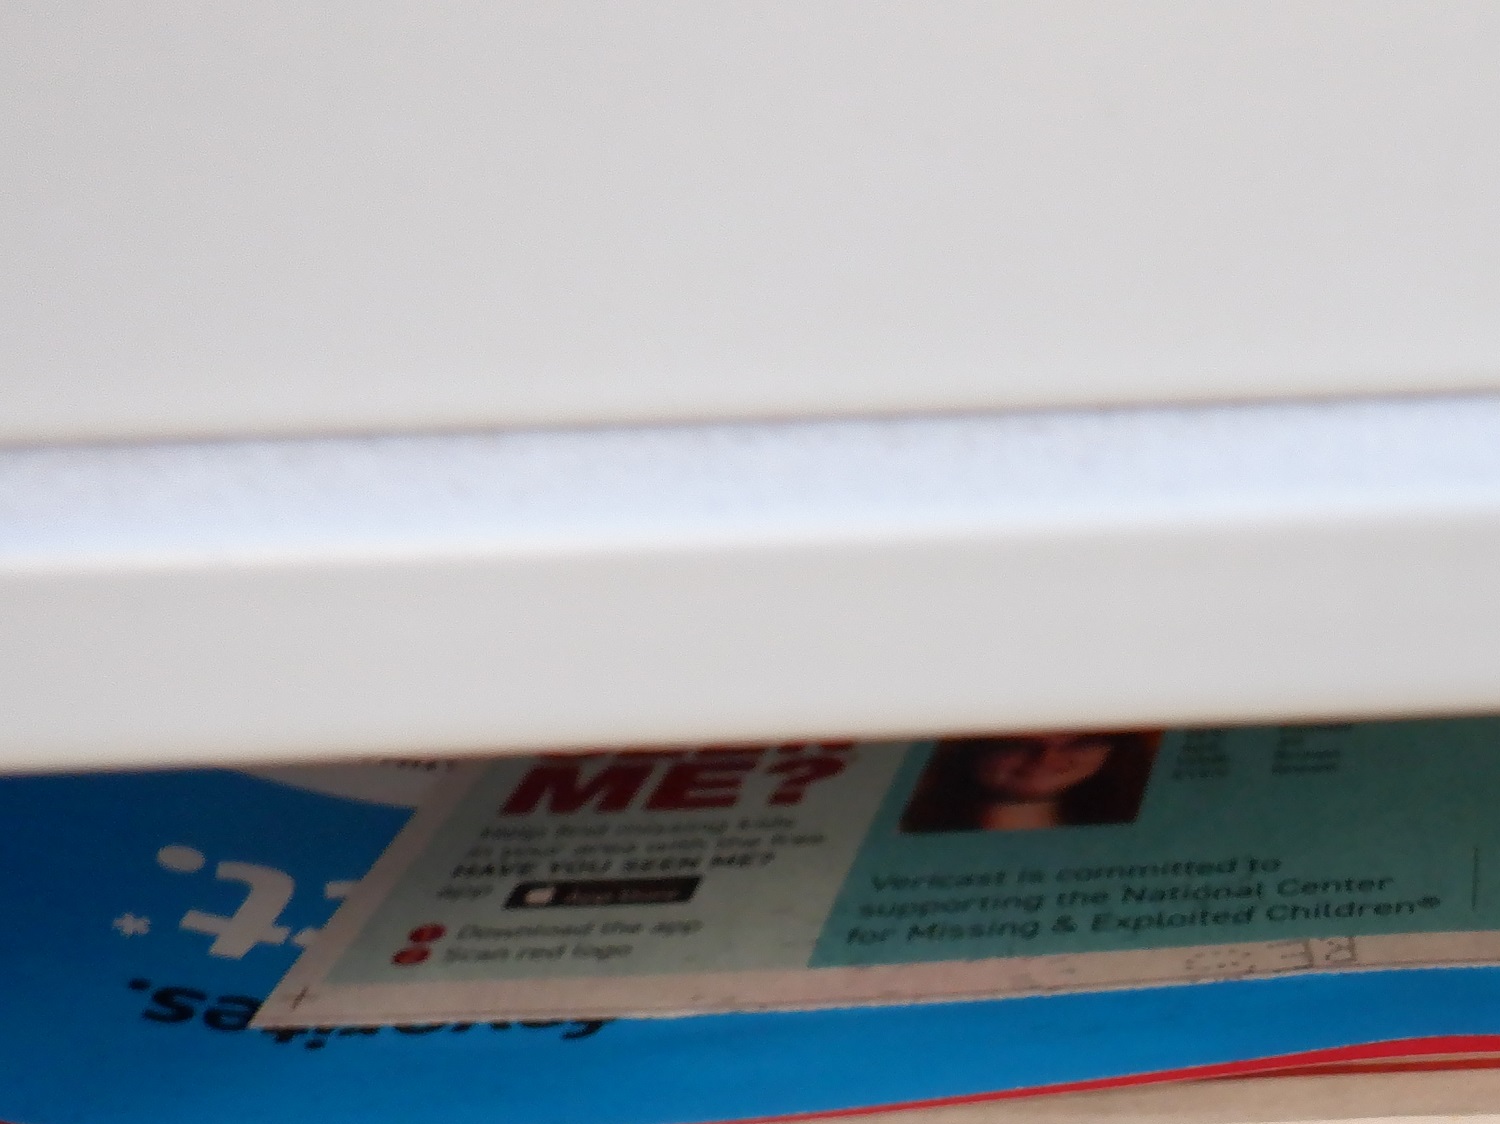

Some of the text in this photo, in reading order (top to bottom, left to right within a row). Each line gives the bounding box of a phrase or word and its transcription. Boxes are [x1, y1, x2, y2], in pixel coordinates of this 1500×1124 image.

[500, 758, 847, 816] ME?
[871, 856, 1283, 892] Vericast is committed to
[858, 876, 1395, 919] supporting the National Center
[847, 925, 894, 944] for
[906, 919, 1041, 943] Missing
[1051, 913, 1079, 934] &
[1091, 904, 1257, 936] Exploited
